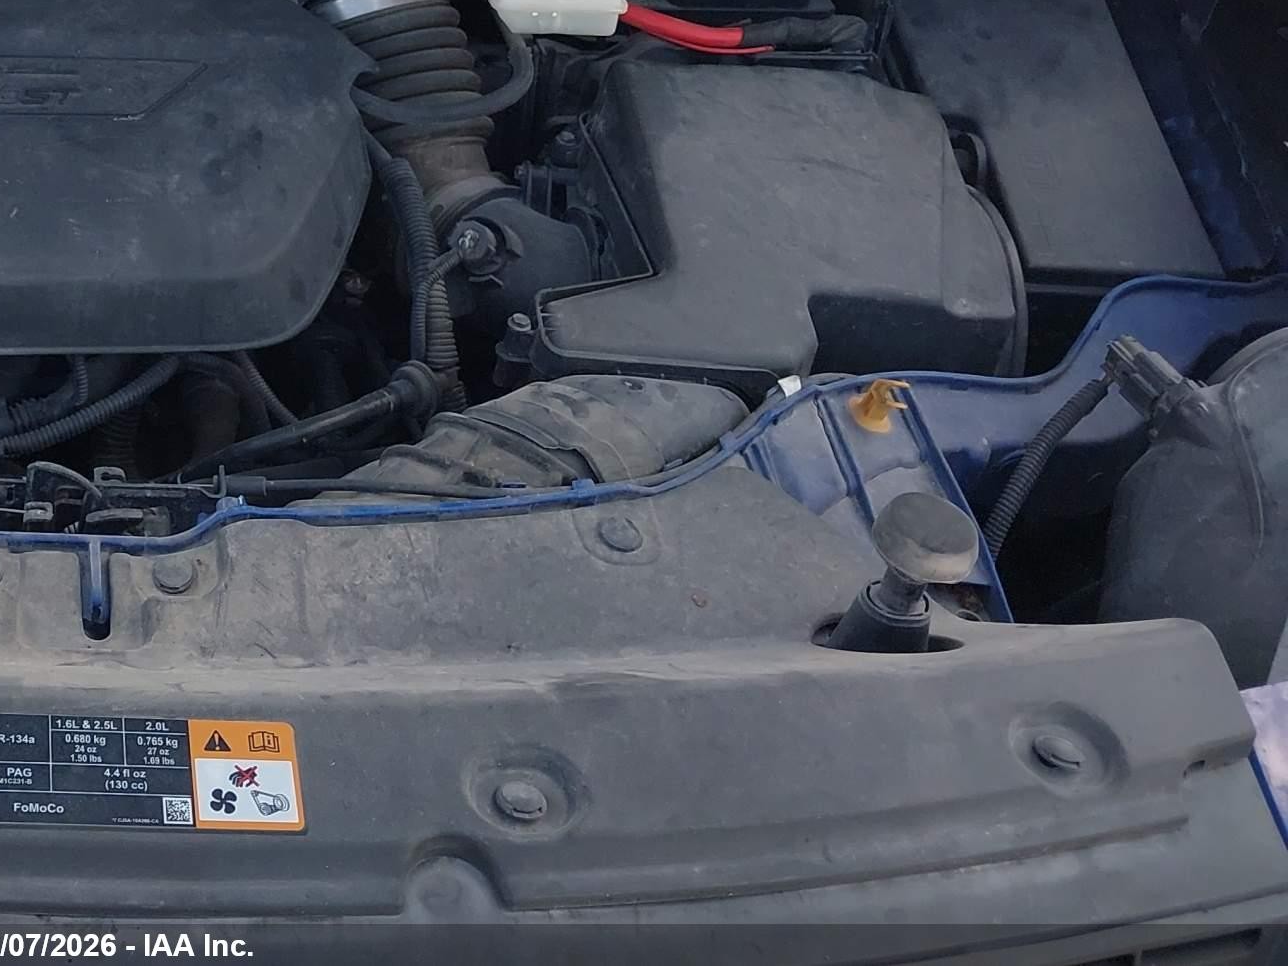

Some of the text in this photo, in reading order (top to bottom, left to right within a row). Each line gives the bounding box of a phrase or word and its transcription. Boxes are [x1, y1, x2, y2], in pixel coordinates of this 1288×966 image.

[56, 719, 118, 730] 1.6L & 2.5L
[145, 722, 169, 731] 2.0L
[65, 733, 107, 746] 0.680 kg
[137, 736, 178, 748] 0.765 kg
[74, 745, 86, 753] 24
[147, 747, 159, 755] 27
[89, 754, 102, 763] lbs
[162, 757, 175, 765] lbs
[7, 767, 32, 777] PAG
[104, 768, 121, 778] 4.4
[123, 769, 130, 778] fl
[105, 780, 148, 792] (130 cc)
[13, 803, 65, 814] FoMoCo
